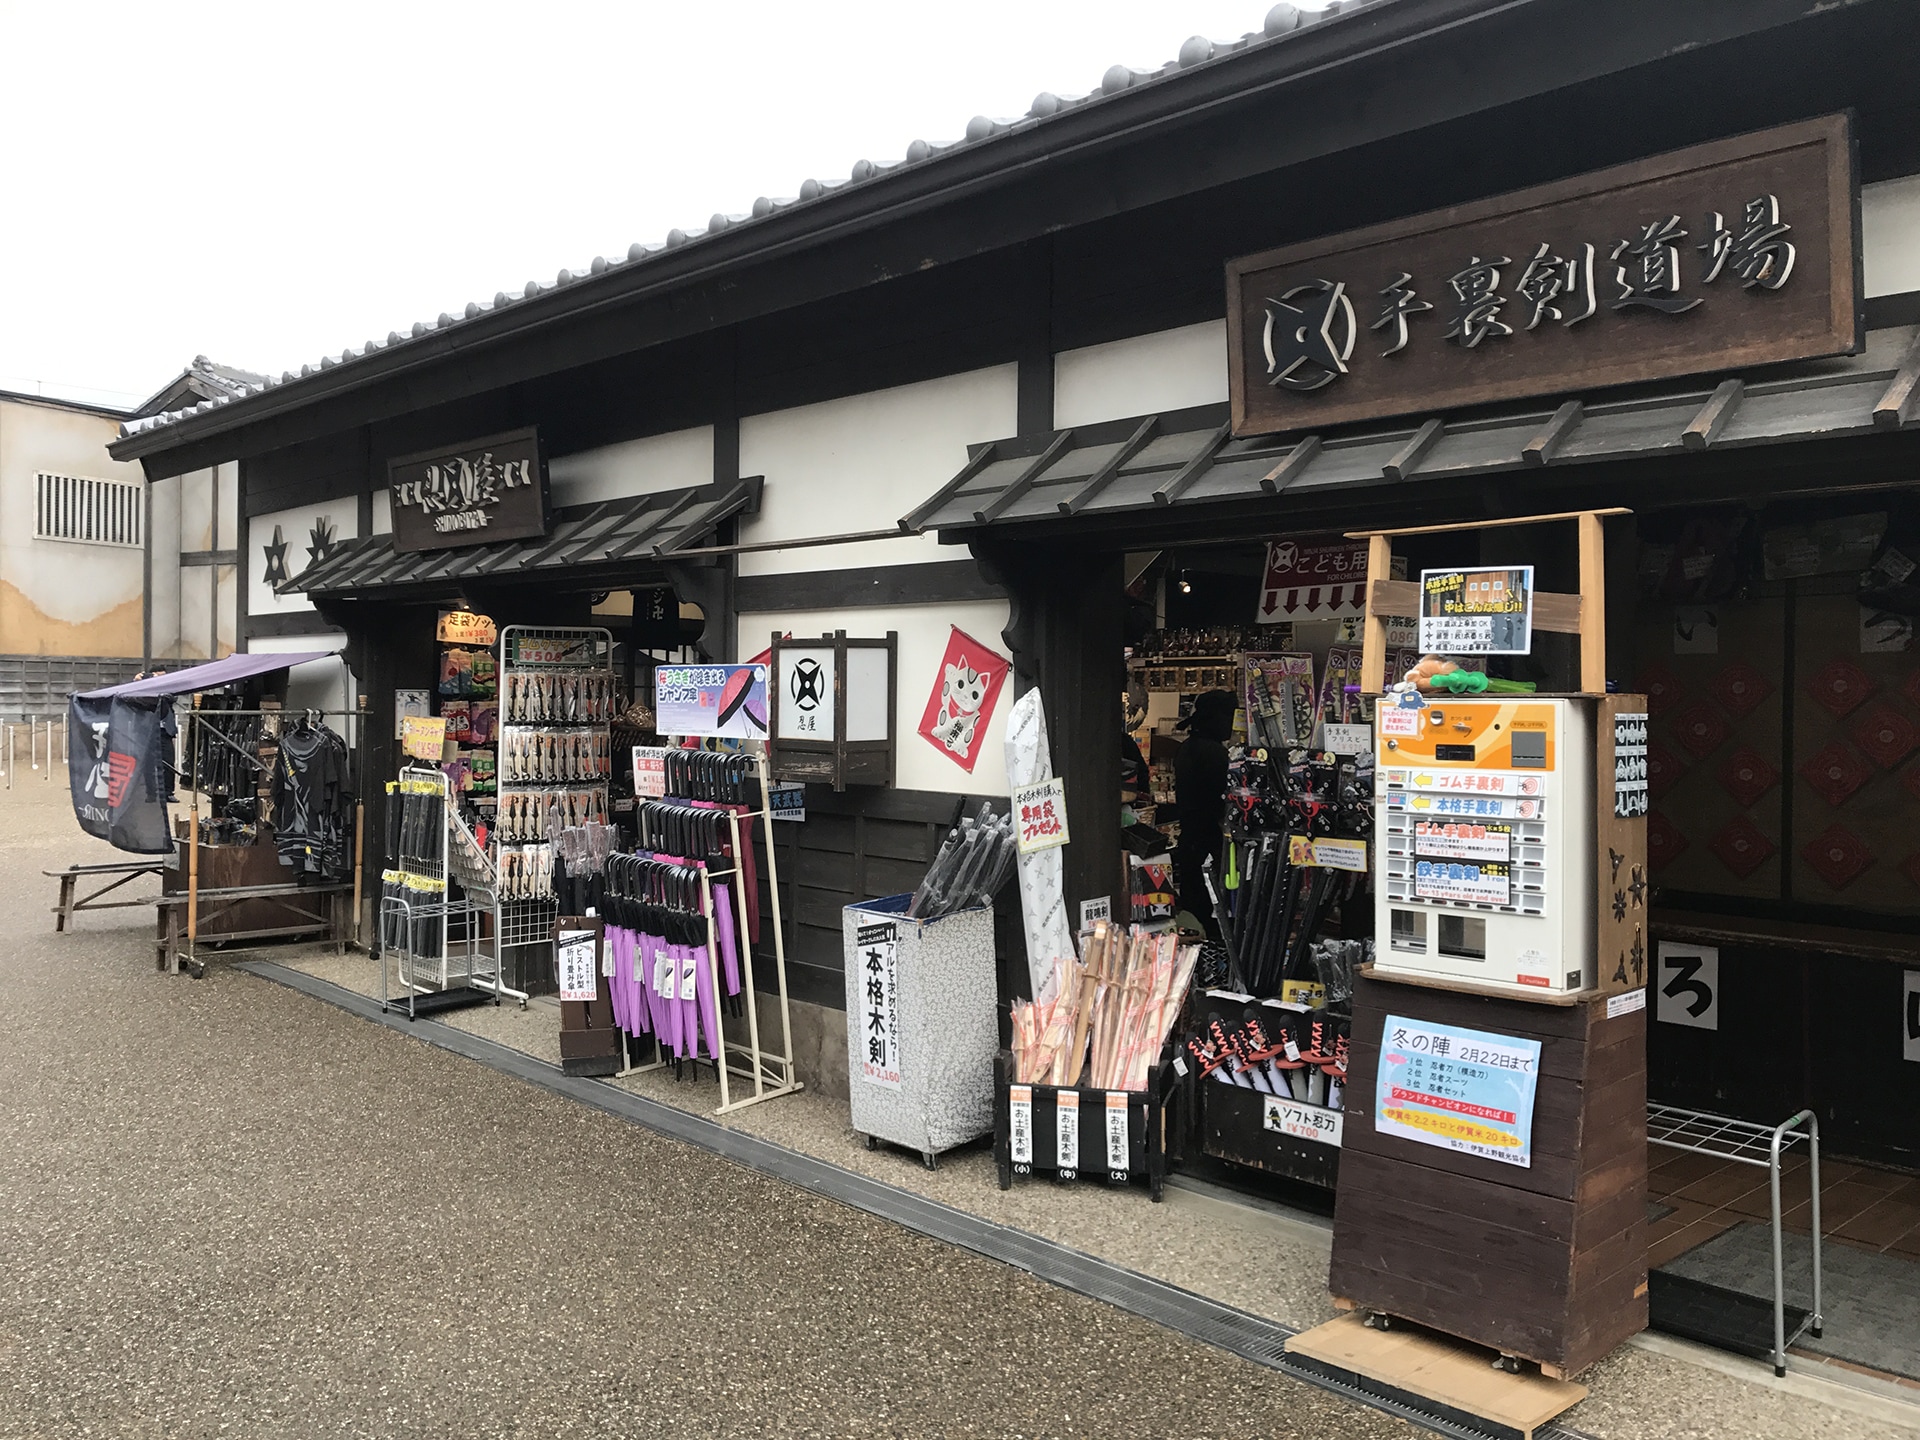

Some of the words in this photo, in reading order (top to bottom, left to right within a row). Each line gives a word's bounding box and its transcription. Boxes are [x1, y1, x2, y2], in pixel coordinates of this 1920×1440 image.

[1369, 194, 1797, 358] 手裏剣道場
[1296, 551, 1368, 574] こども用
[518, 638, 572, 651] ゴムクナイ
[1331, 735, 1369, 743] フリスビー
[1439, 775, 1505, 791] ゴム手裏剣
[1021, 799, 1056, 823] 専用袋
[1436, 797, 1503, 815] 本格手裏剣
[1416, 822, 1486, 840] ゴム手裏剣
[1416, 861, 1480, 881] 鉄手裏剣
[1441, 890, 1461, 898] years
[567, 947, 575, 990] 折り畳み傘
[567, 991, 596, 1000] ¥1,620
[1662, 956, 1713, 1018] ろ
[865, 947, 887, 1067] 本格木剣
[1392, 1028, 1451, 1057] 冬の陣
[1409, 1057, 1423, 1067] 1位
[1459, 1047, 1535, 1073] 2月22日まで
[869, 1066, 899, 1084] ¥2,160
[1407, 1068, 1423, 1078] 2位
[1429, 1072, 1469, 1086] 忍者スーツ
[1406, 1079, 1421, 1089] 3位
[1428, 1083, 1467, 1098] 忍者セット
[1283, 1107, 1335, 1132] ソフト忍刀
[1291, 1124, 1318, 1138] ¥700
[1014, 1165, 1030, 1174] (小)
[1060, 1169, 1076, 1179] (中)
[1111, 1171, 1127, 1181] (大)
